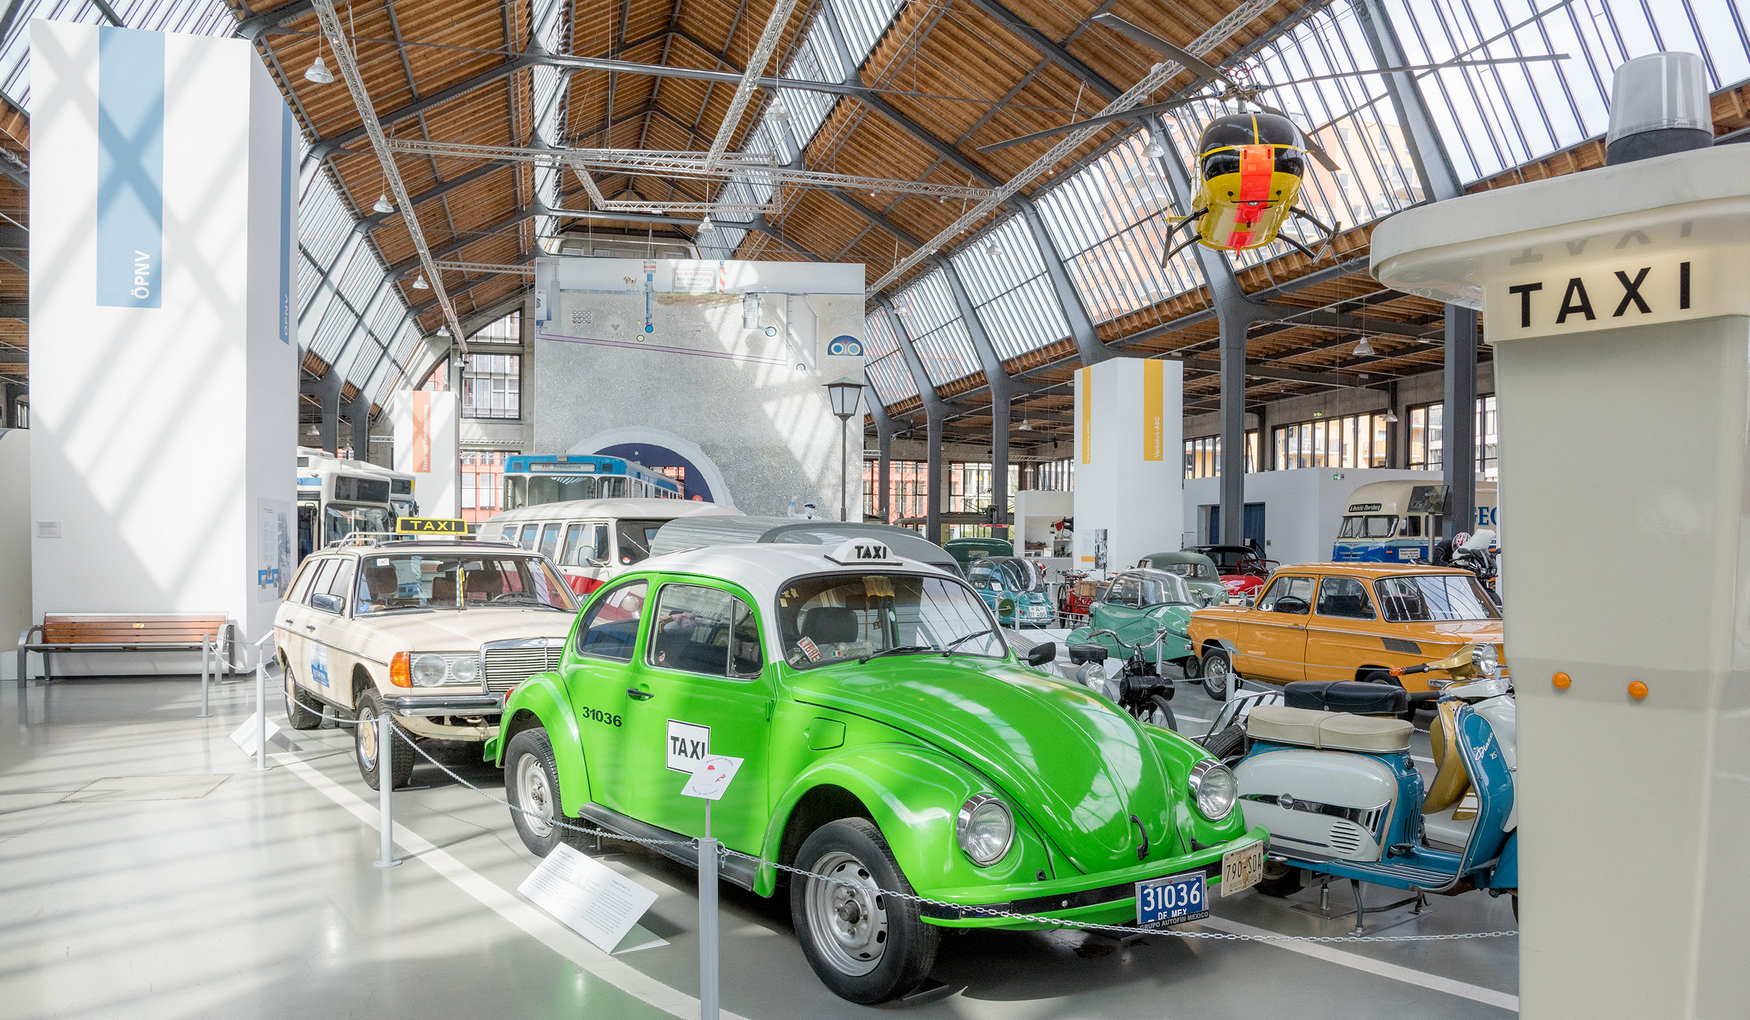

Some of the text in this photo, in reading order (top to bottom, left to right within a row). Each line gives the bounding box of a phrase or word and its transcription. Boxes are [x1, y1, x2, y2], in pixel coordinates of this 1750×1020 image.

[131, 250, 150, 299] ÖPNV
[1509, 261, 1691, 328] TAXI
[410, 520, 456, 531] TAXI
[854, 545, 887, 559] TAXI
[582, 706, 623, 727] 31036
[670, 735, 706, 760] TAXI
[1143, 882, 1201, 912] 31036
[1187, 911, 1209, 921] MEXICO
